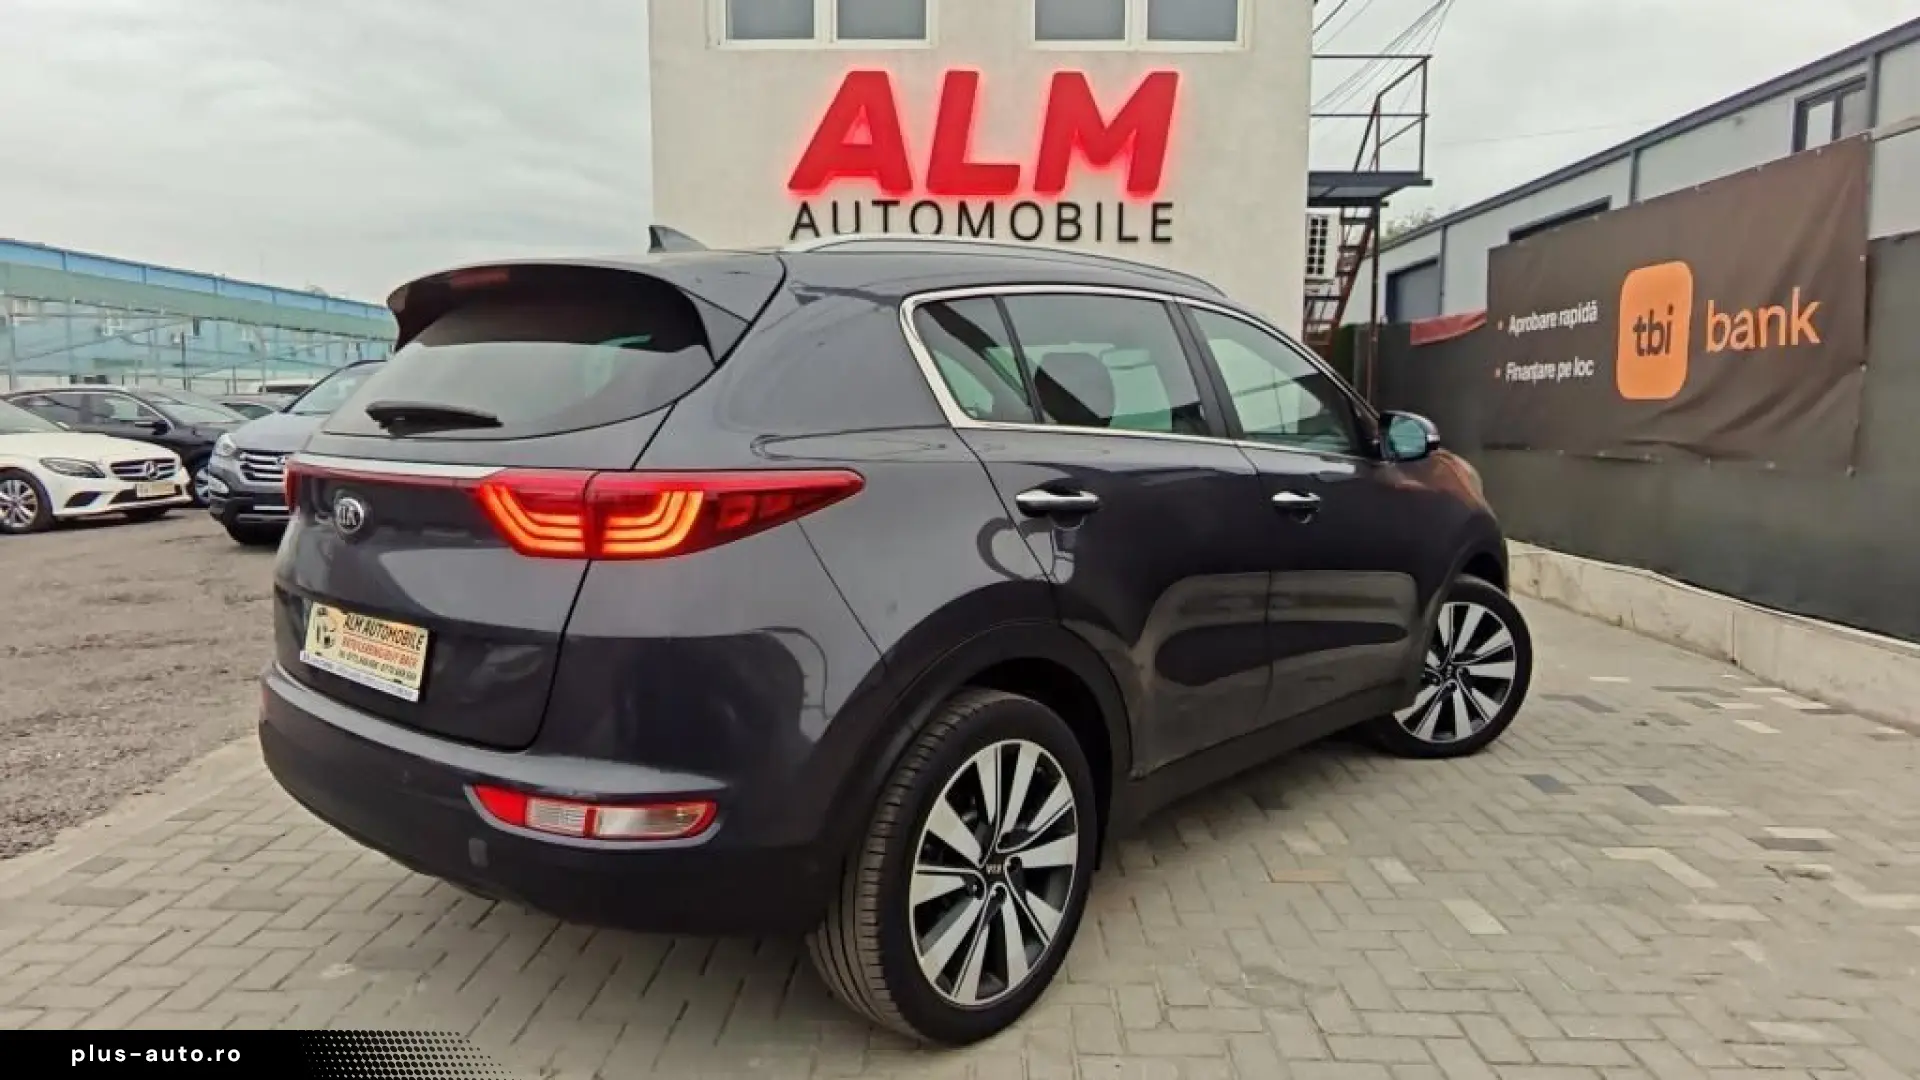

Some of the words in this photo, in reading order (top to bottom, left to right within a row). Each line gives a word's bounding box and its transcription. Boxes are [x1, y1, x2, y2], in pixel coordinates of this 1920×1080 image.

[788, 70, 1180, 195] ALM
[790, 200, 1173, 242] AUTOMOBILE
[1507, 312, 1557, 336] Aprobare
[1558, 300, 1599, 331] rapidă
[1632, 304, 1674, 357] tbi
[1706, 287, 1821, 353] bank
[1556, 361, 1572, 382] pe
[1573, 356, 1595, 378] loc
[362, 618, 425, 651] AUTOMOBILE
